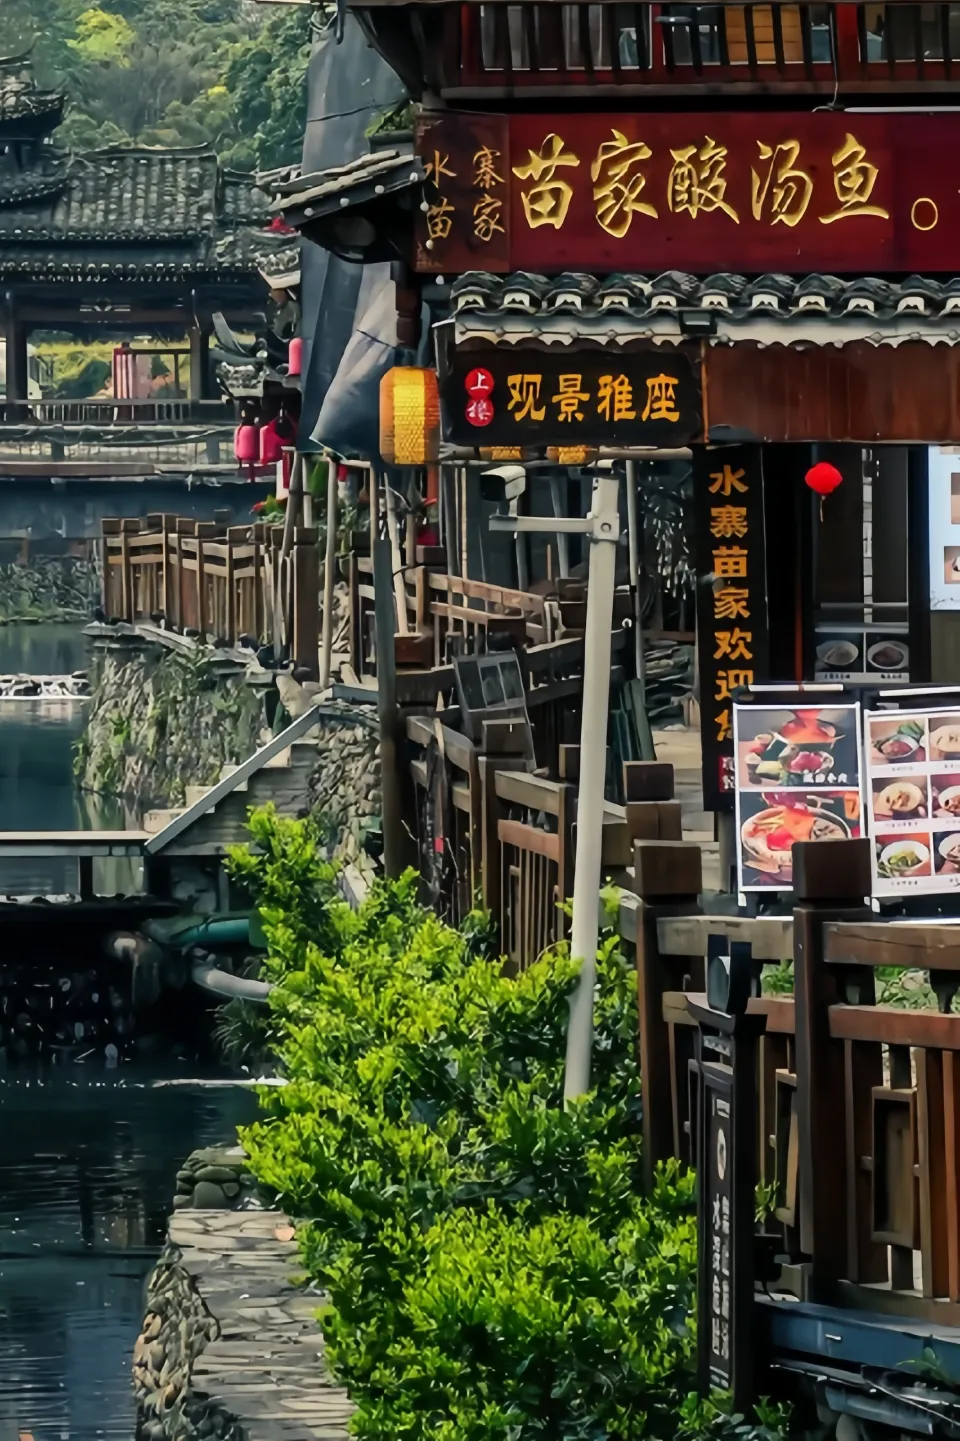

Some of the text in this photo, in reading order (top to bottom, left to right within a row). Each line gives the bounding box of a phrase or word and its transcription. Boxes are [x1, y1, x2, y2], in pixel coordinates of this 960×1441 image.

[512, 128, 889, 238] 苗家酸汤鱼
[507, 373, 681, 422] 观景雅座
